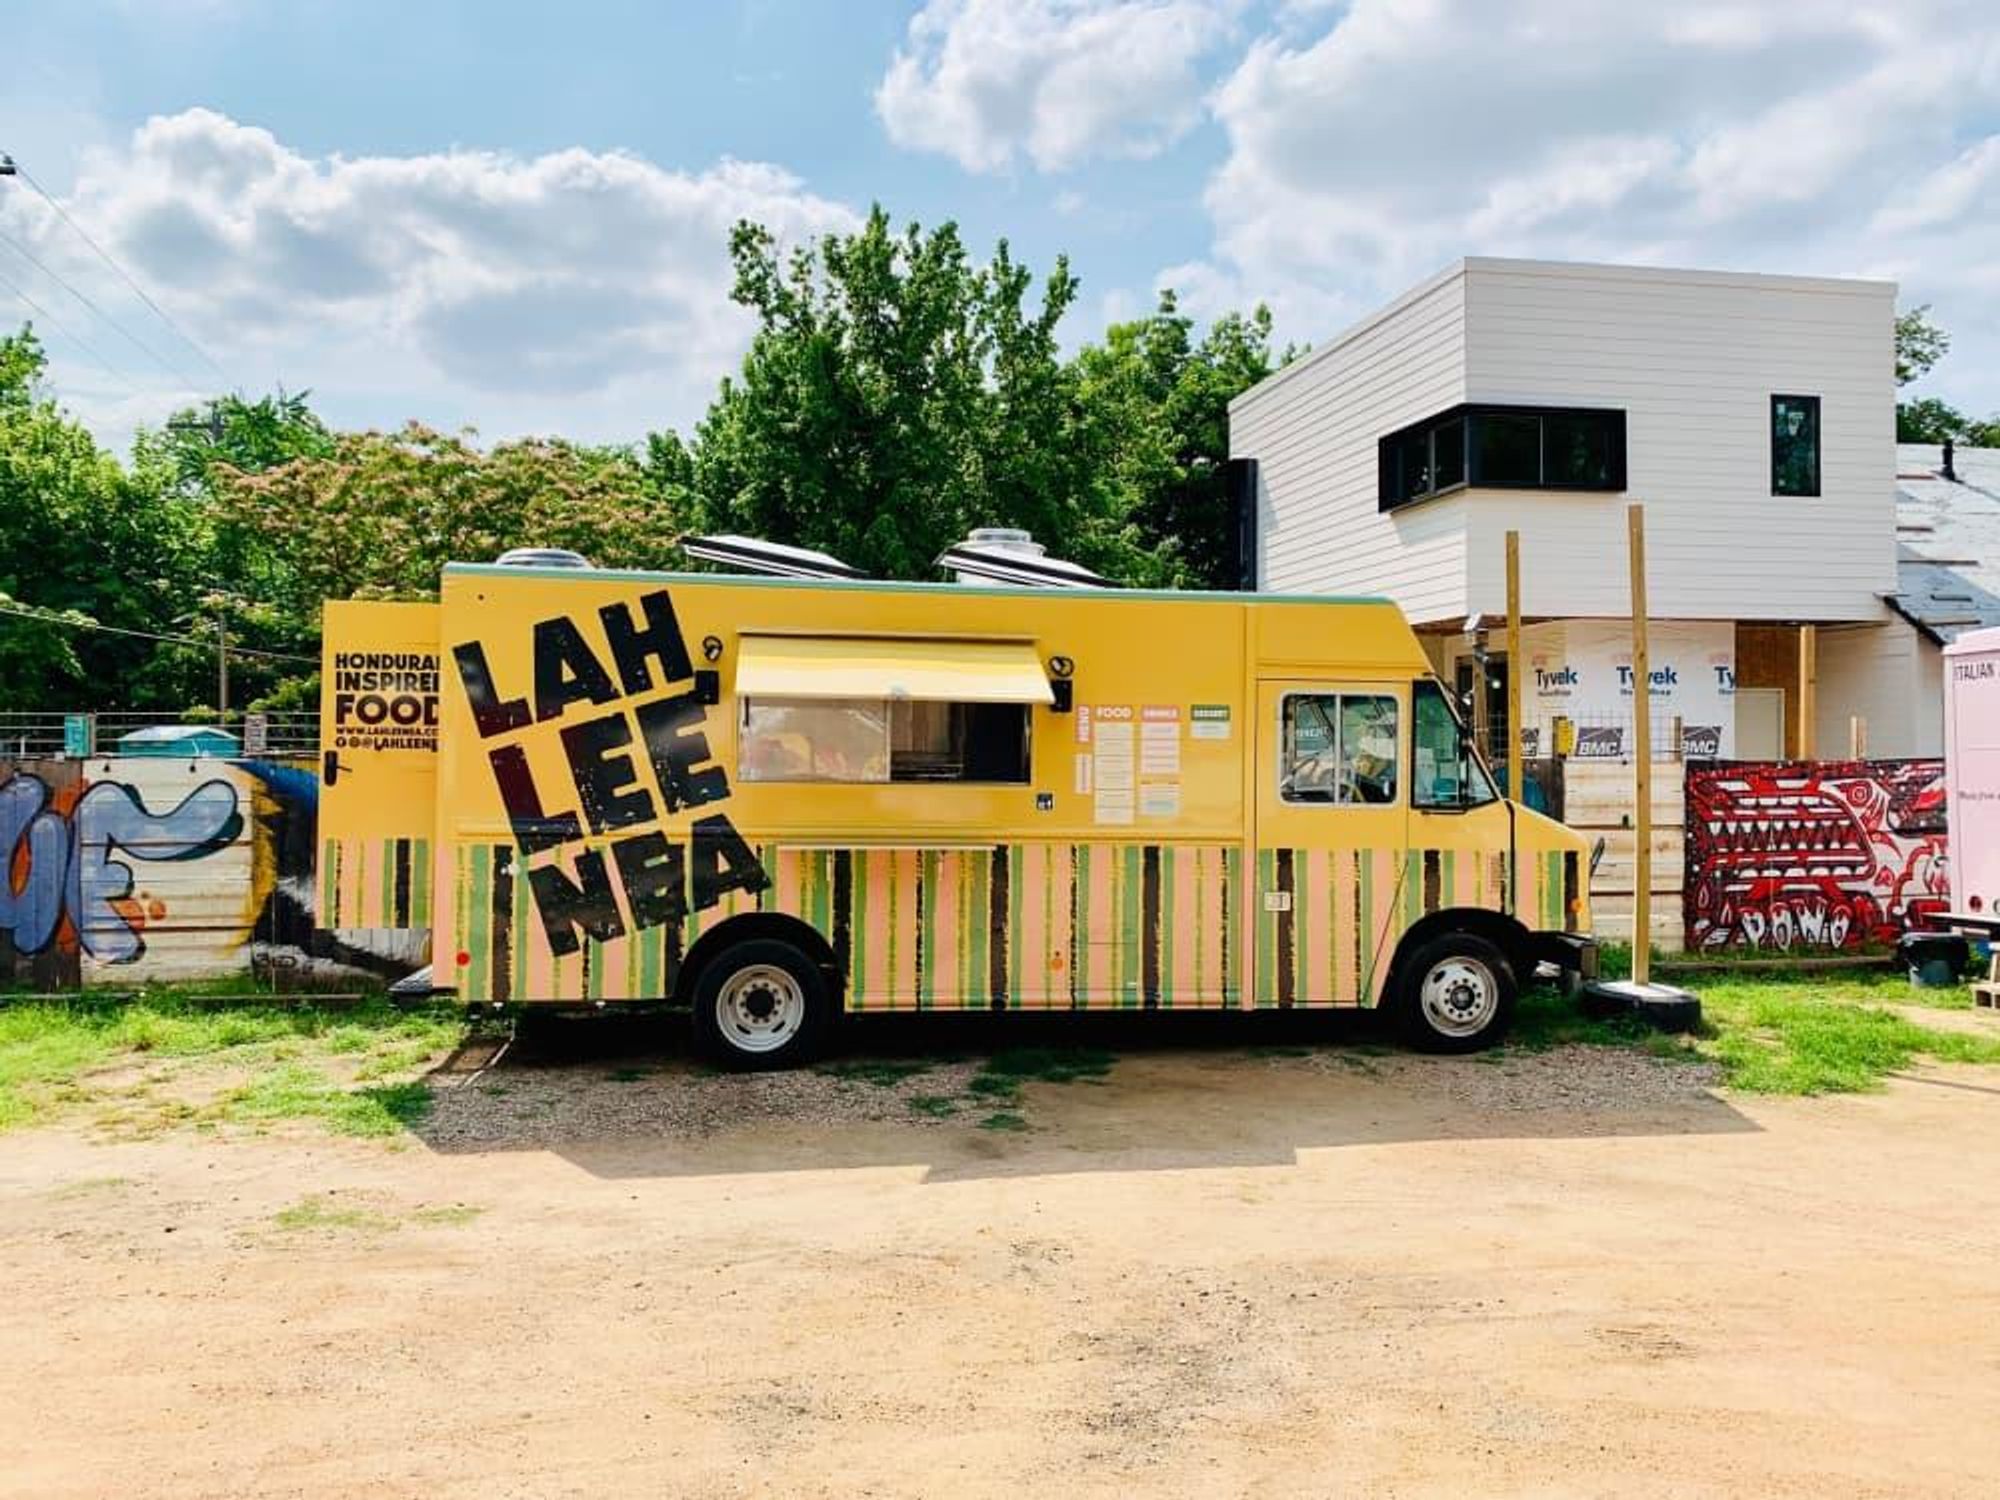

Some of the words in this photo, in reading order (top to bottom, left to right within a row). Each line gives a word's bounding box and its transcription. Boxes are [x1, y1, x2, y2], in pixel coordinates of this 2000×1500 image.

[452, 589, 695, 738] LAH
[1535, 666, 1578, 689] Tyvek
[488, 692, 732, 856] LEE
[1578, 741, 1618, 755] BMC
[528, 813, 772, 957] NBA
